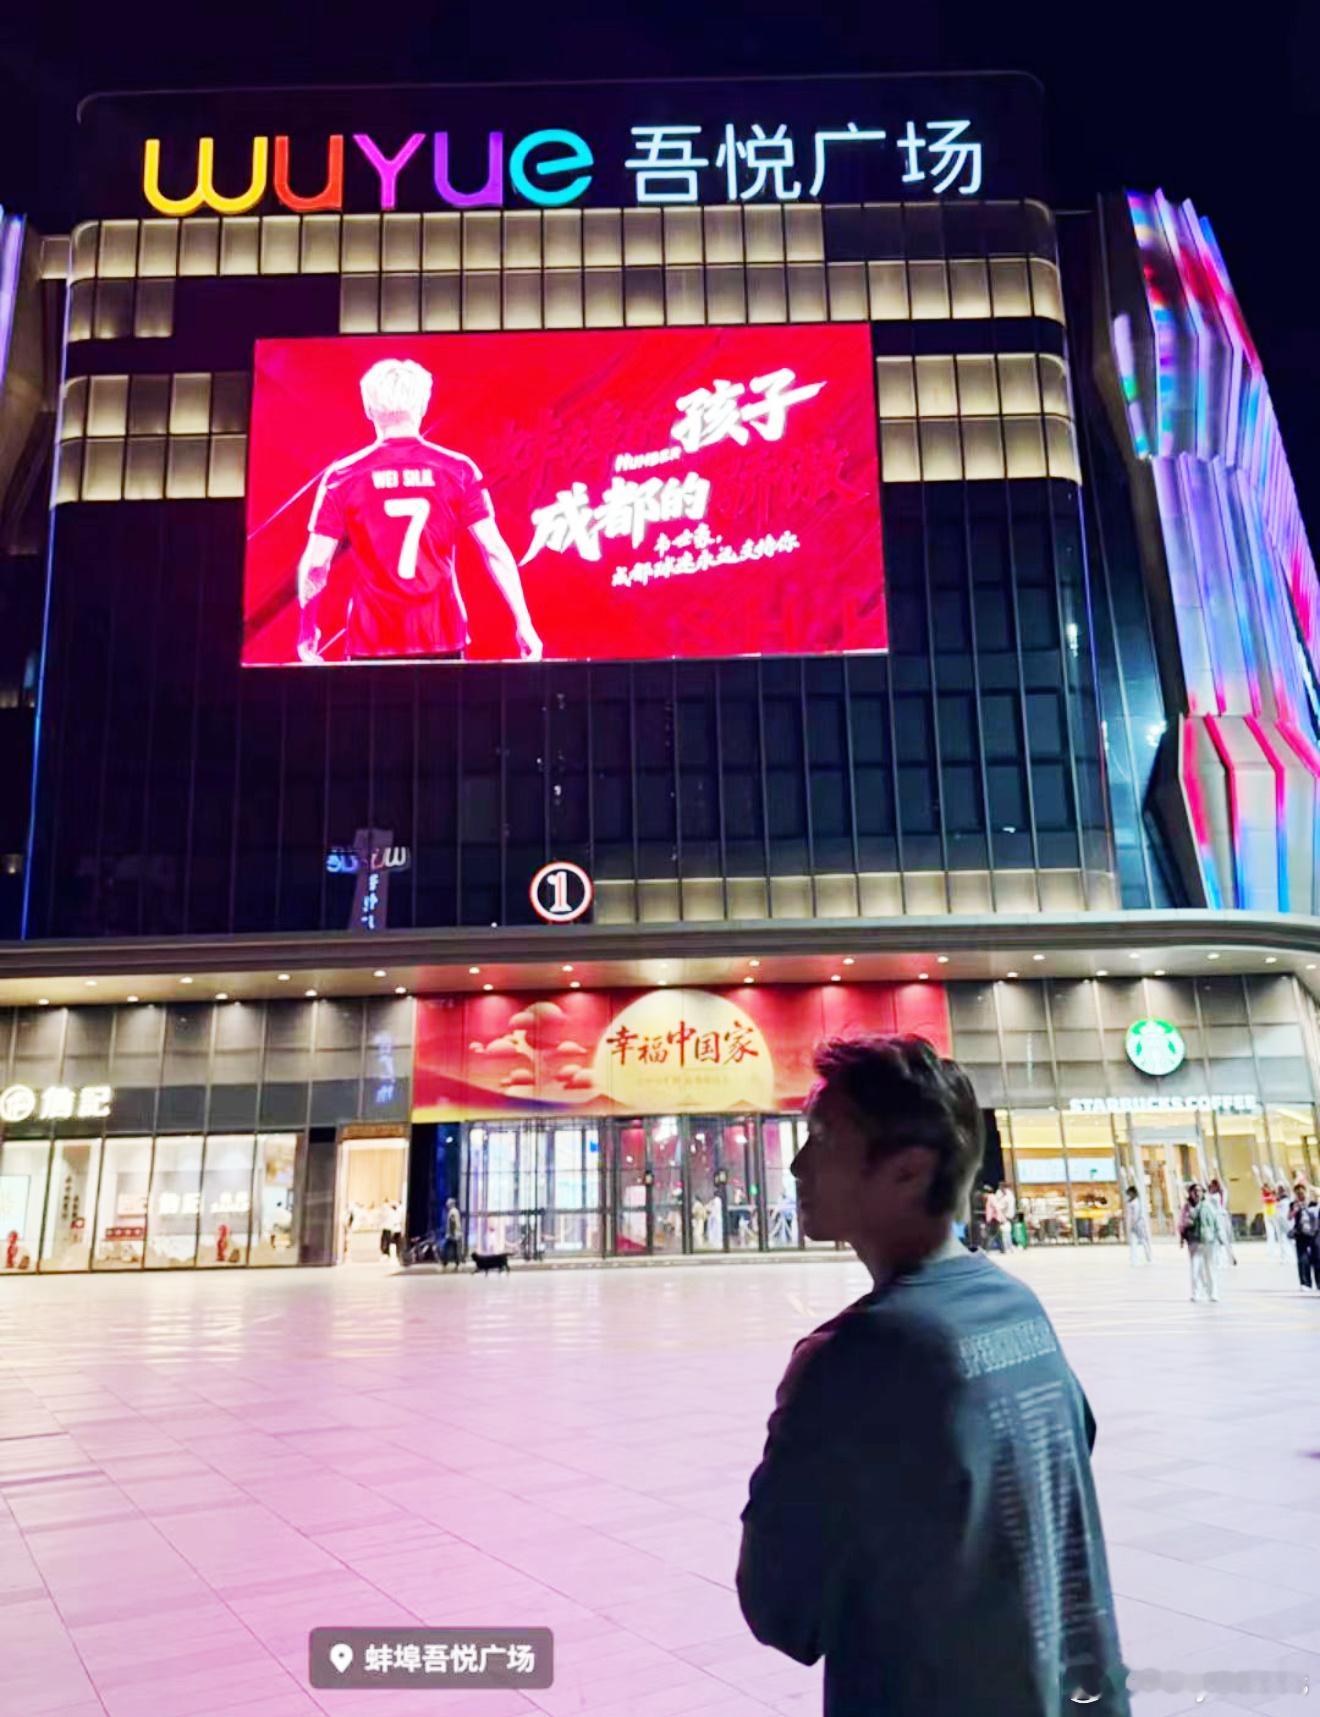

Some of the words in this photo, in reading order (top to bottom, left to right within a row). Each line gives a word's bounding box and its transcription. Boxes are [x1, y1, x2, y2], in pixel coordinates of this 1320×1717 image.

[624, 120, 983, 203] 吾悦广场
[670, 367, 828, 453] 孩子
[384, 497, 431, 580] 7
[518, 471, 711, 562] 成都的
[606, 1020, 759, 1067] 幸福中国家
[1069, 1096, 1186, 1113] STARBUCKS
